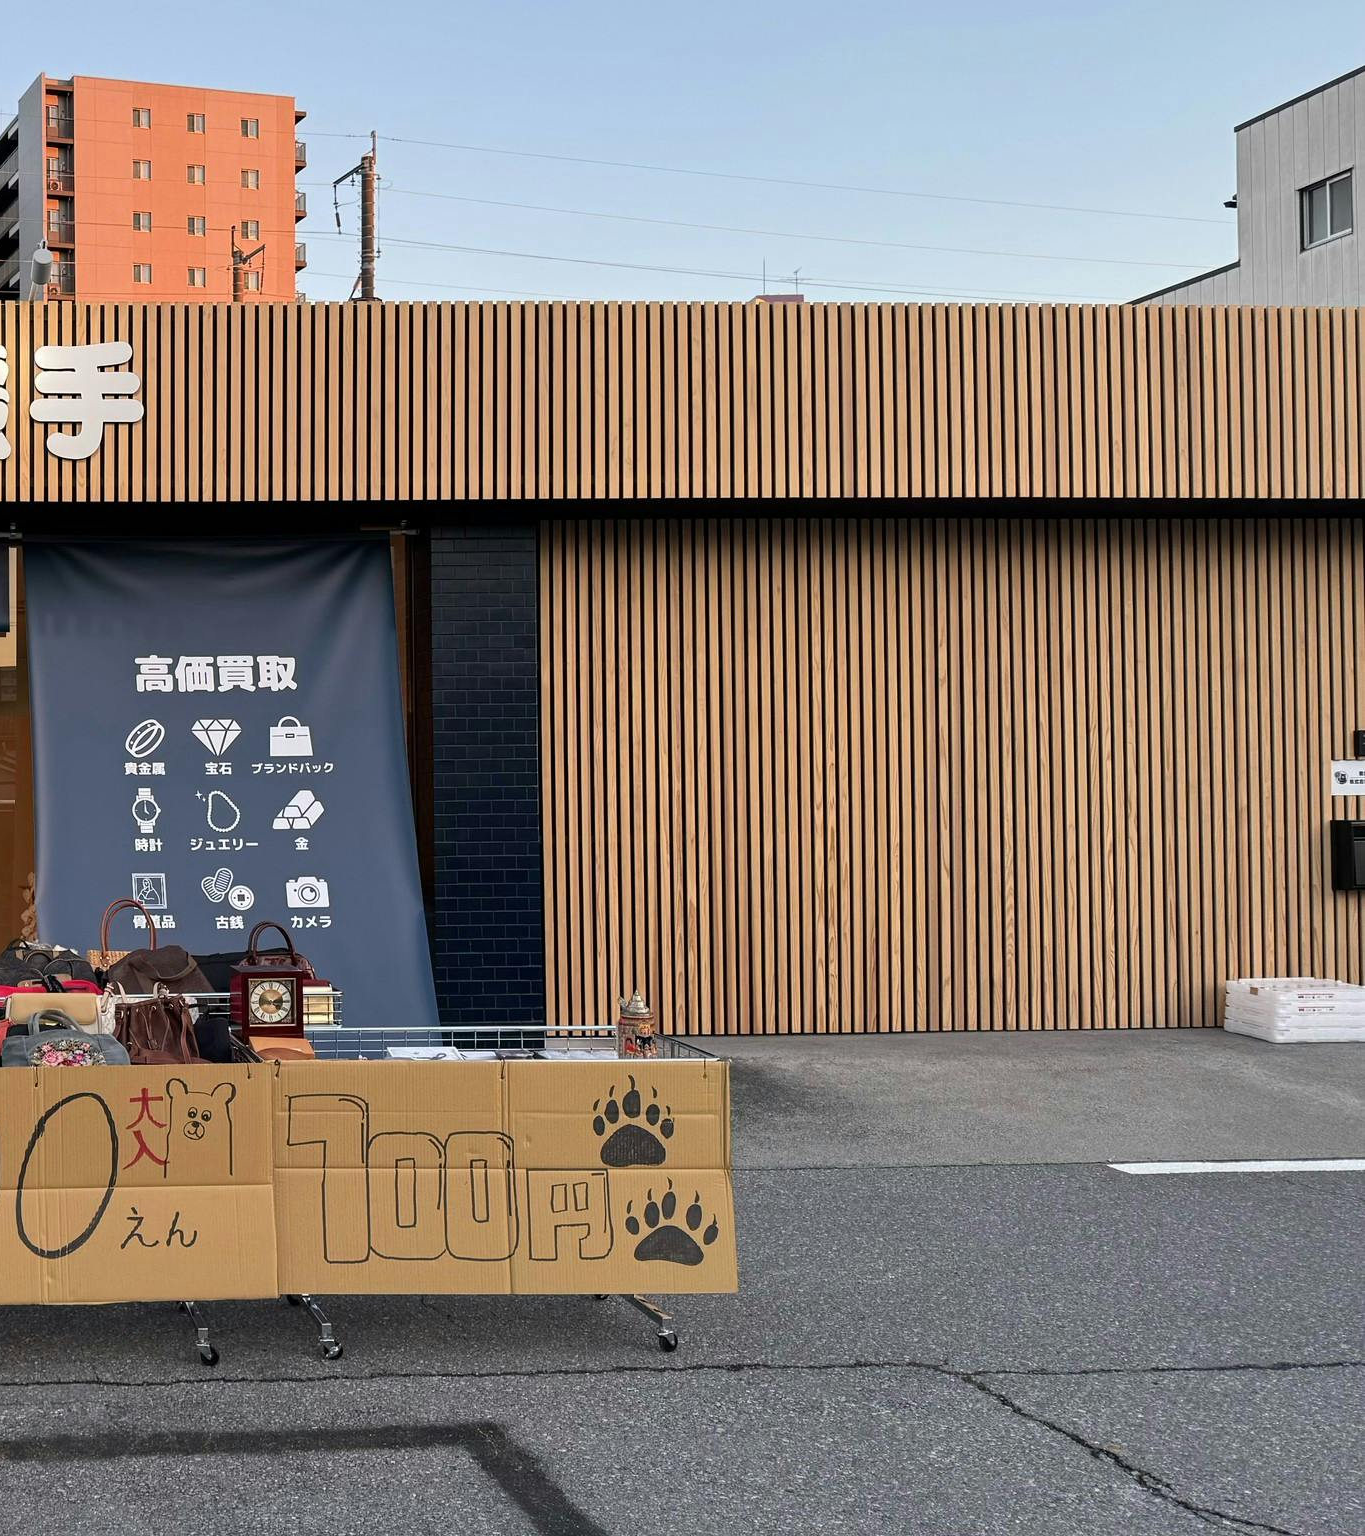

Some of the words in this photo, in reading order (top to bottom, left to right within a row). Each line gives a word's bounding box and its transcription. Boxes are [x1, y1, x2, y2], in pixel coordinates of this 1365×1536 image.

[134, 654, 298, 693] 高価買取
[124, 761, 166, 776] 貴金属
[205, 761, 233, 776] 宝石
[134, 838, 163, 852] 時計
[190, 838, 259, 852] ジュエリー
[294, 836, 310, 851] 金
[215, 915, 244, 930] 古銭
[290, 915, 333, 929] カメラ
[122, 1087, 170, 1171] 大入
[285, 1093, 615, 1264] 100円
